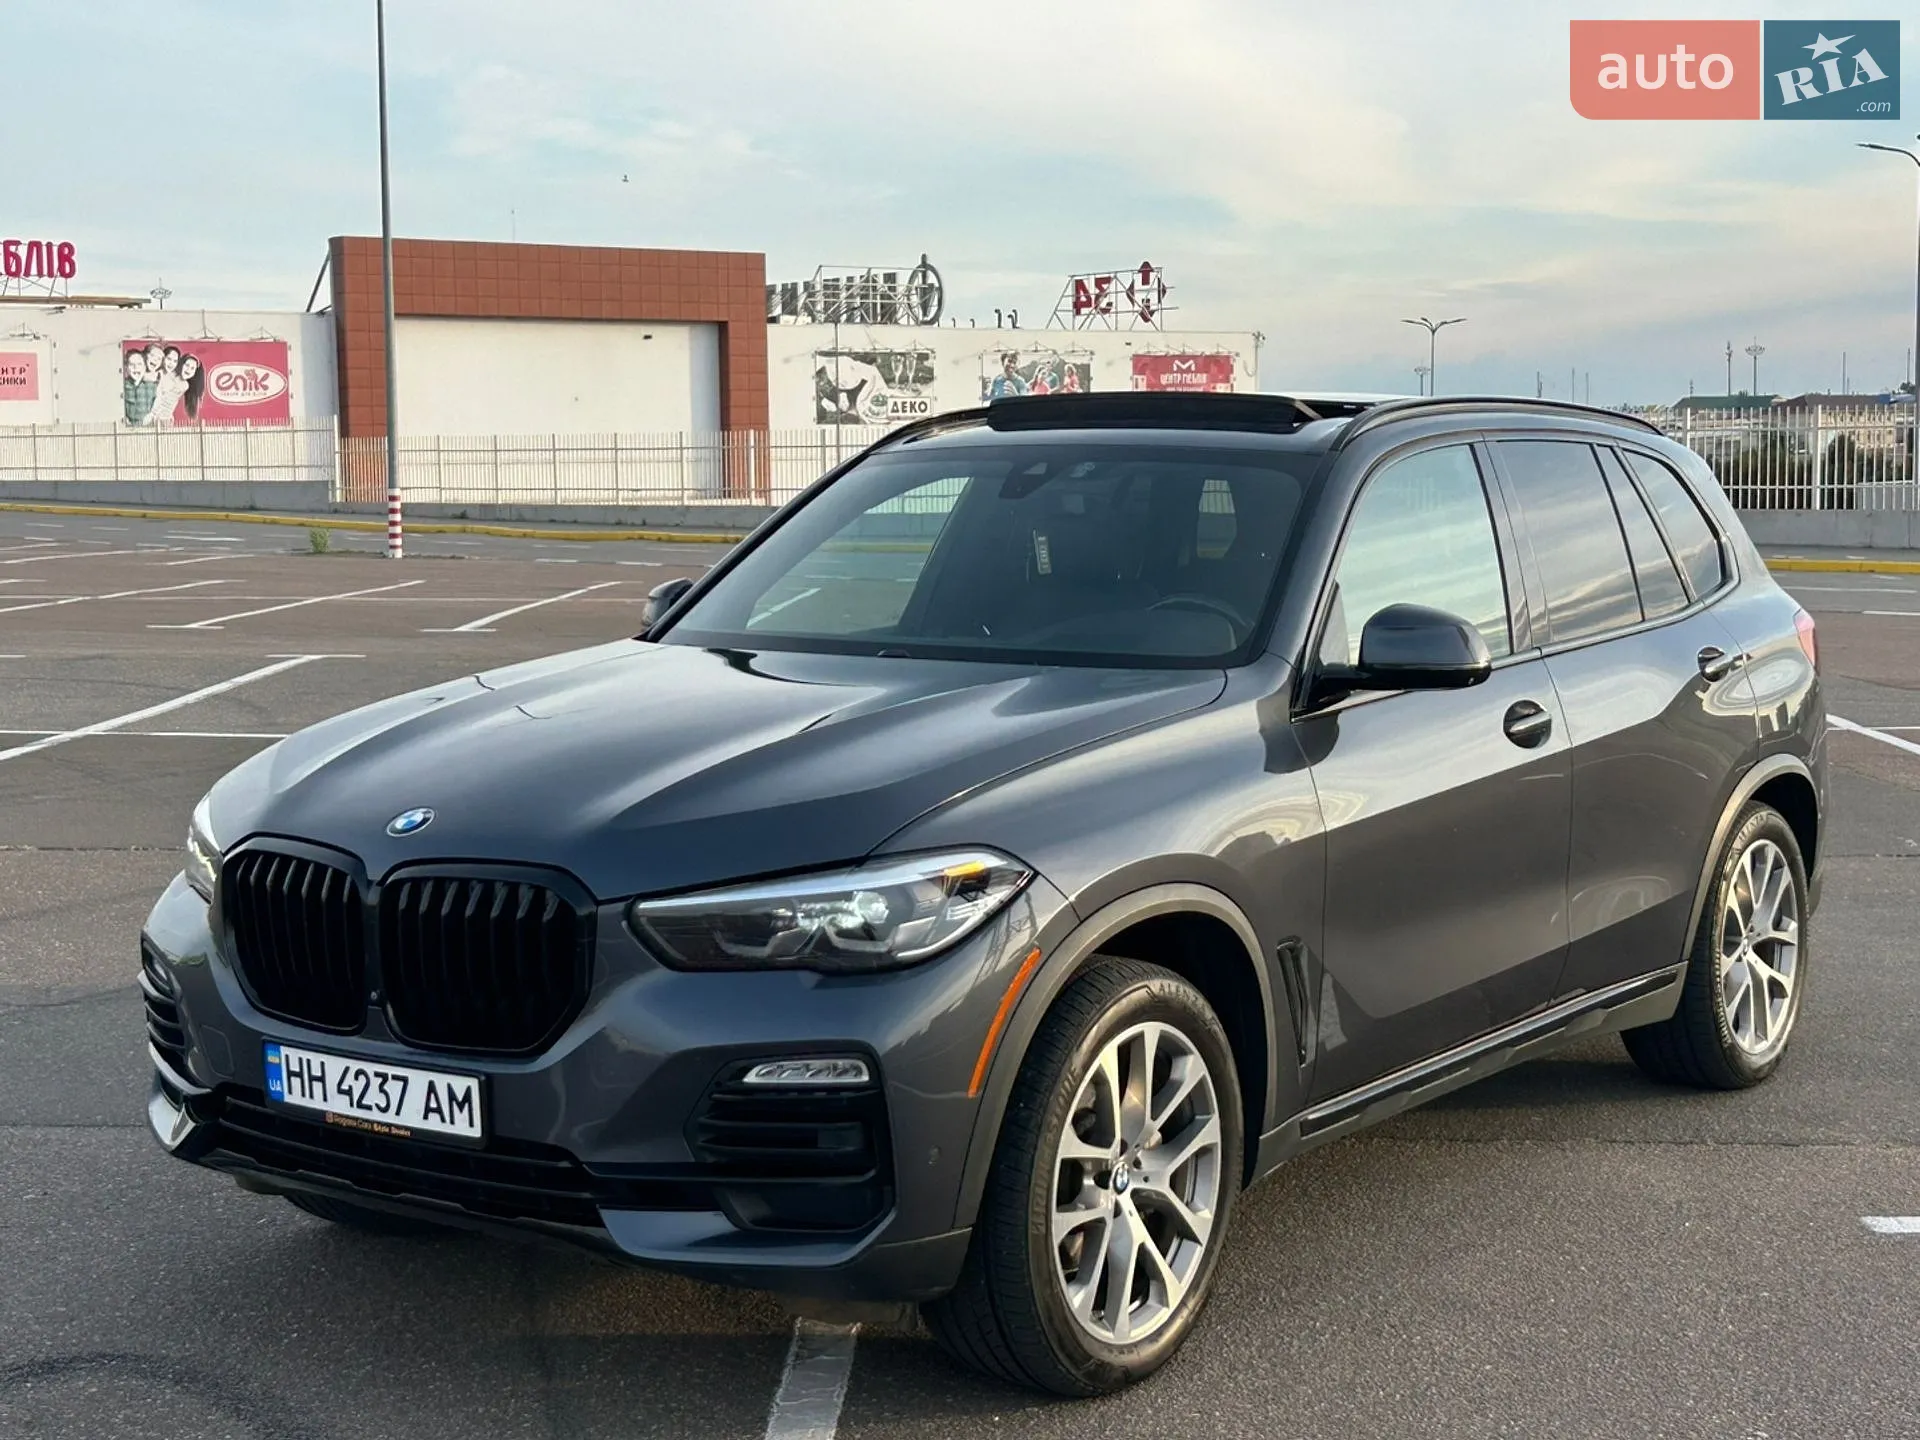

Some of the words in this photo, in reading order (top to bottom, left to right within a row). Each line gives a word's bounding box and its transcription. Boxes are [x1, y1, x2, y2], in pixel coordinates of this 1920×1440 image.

[2, 240, 76, 279] БЛІВ
[1, 366, 26, 375] НТР
[269, 1079, 282, 1092] UA
[285, 1053, 328, 1102] HH
[336, 1065, 409, 1117] 4237
[423, 1079, 474, 1128] AM
